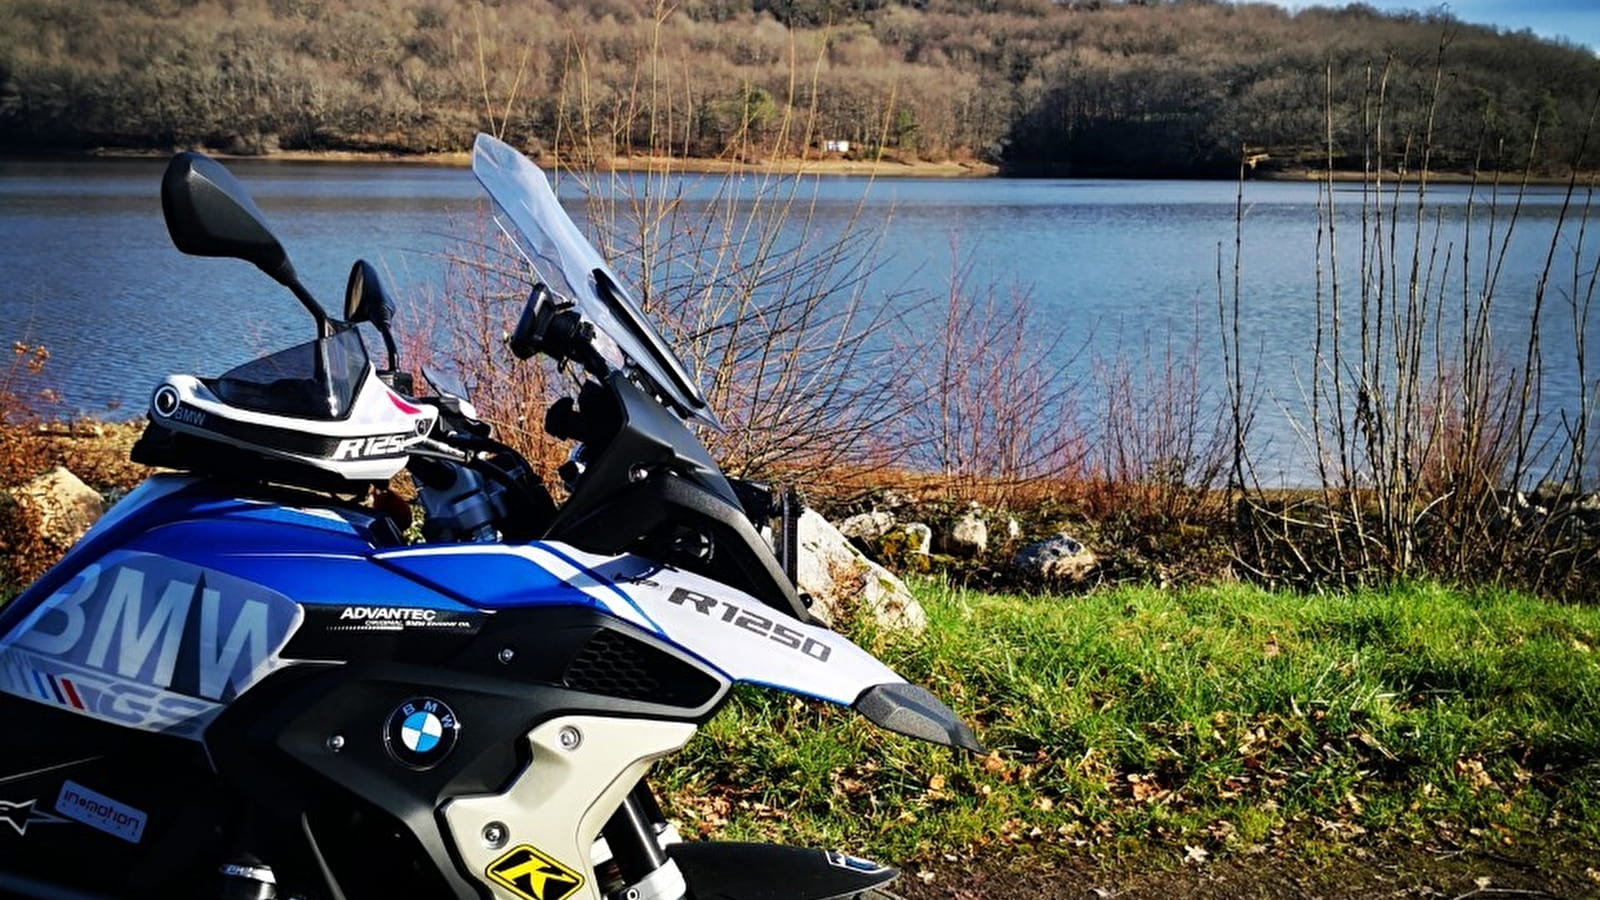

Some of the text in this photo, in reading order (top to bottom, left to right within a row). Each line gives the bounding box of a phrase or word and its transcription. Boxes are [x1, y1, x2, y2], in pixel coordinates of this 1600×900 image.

[175, 407, 206, 425] BMW
[331, 435, 407, 459] R125
[340, 607, 436, 621] ADVANTEC
[668, 587, 832, 663] R1250
[12, 562, 271, 701] BMW
[403, 701, 454, 728] BMW
[493, 854, 577, 900] K
